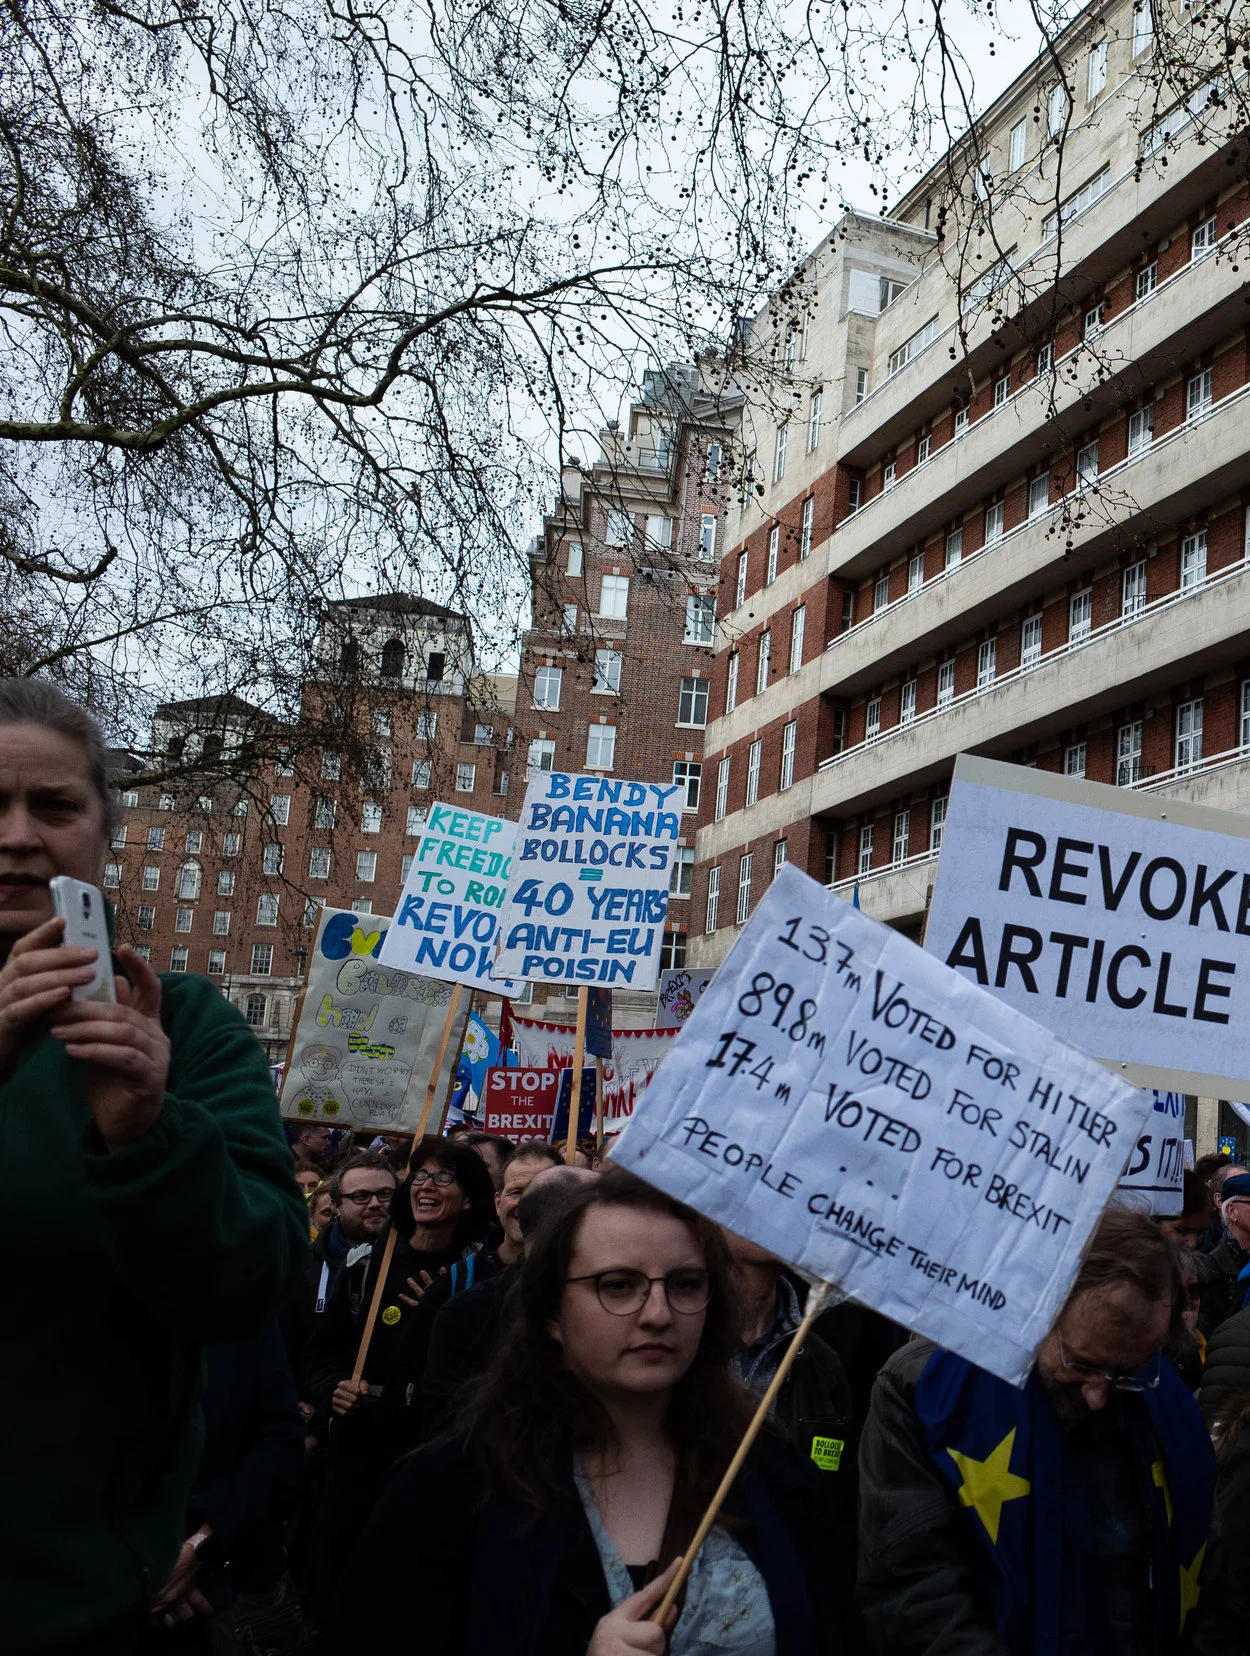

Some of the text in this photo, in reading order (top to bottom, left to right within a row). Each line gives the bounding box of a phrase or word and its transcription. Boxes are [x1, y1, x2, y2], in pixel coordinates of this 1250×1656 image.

[545, 774, 679, 809] BENDY
[428, 805, 503, 844] KEEP
[527, 803, 679, 840] BANANA
[520, 839, 669, 870] BOLLOCKS
[512, 879, 669, 924] 40 YEARS
[397, 894, 500, 945] REVO
[506, 923, 654, 956] ANTI-EU
[521, 955, 636, 983] POISIN
[946, 916, 1236, 1024] ARTICLE
[778, 917, 1117, 1148] 13.7m VOTED FOR HITLER
[377, 1066, 410, 1076] WORRY
[491, 1072, 555, 1091] STOP
[738, 972, 1090, 1184] 89.8m VOTED FOR STALIN
[351, 1099, 398, 1112] CUNNING
[352, 1086, 375, 1096] HAVE
[510, 1096, 534, 1106] THE
[369, 1109, 394, 1119] PLAN
[488, 1114, 553, 1129] BREXIT
[825, 1083, 921, 1153] VOTED
[930, 1147, 982, 1188] FOR
[985, 1174, 1070, 1234] BREXIT
[683, 1117, 1006, 1310] PEOPLE CHANGE THEIR MIND
